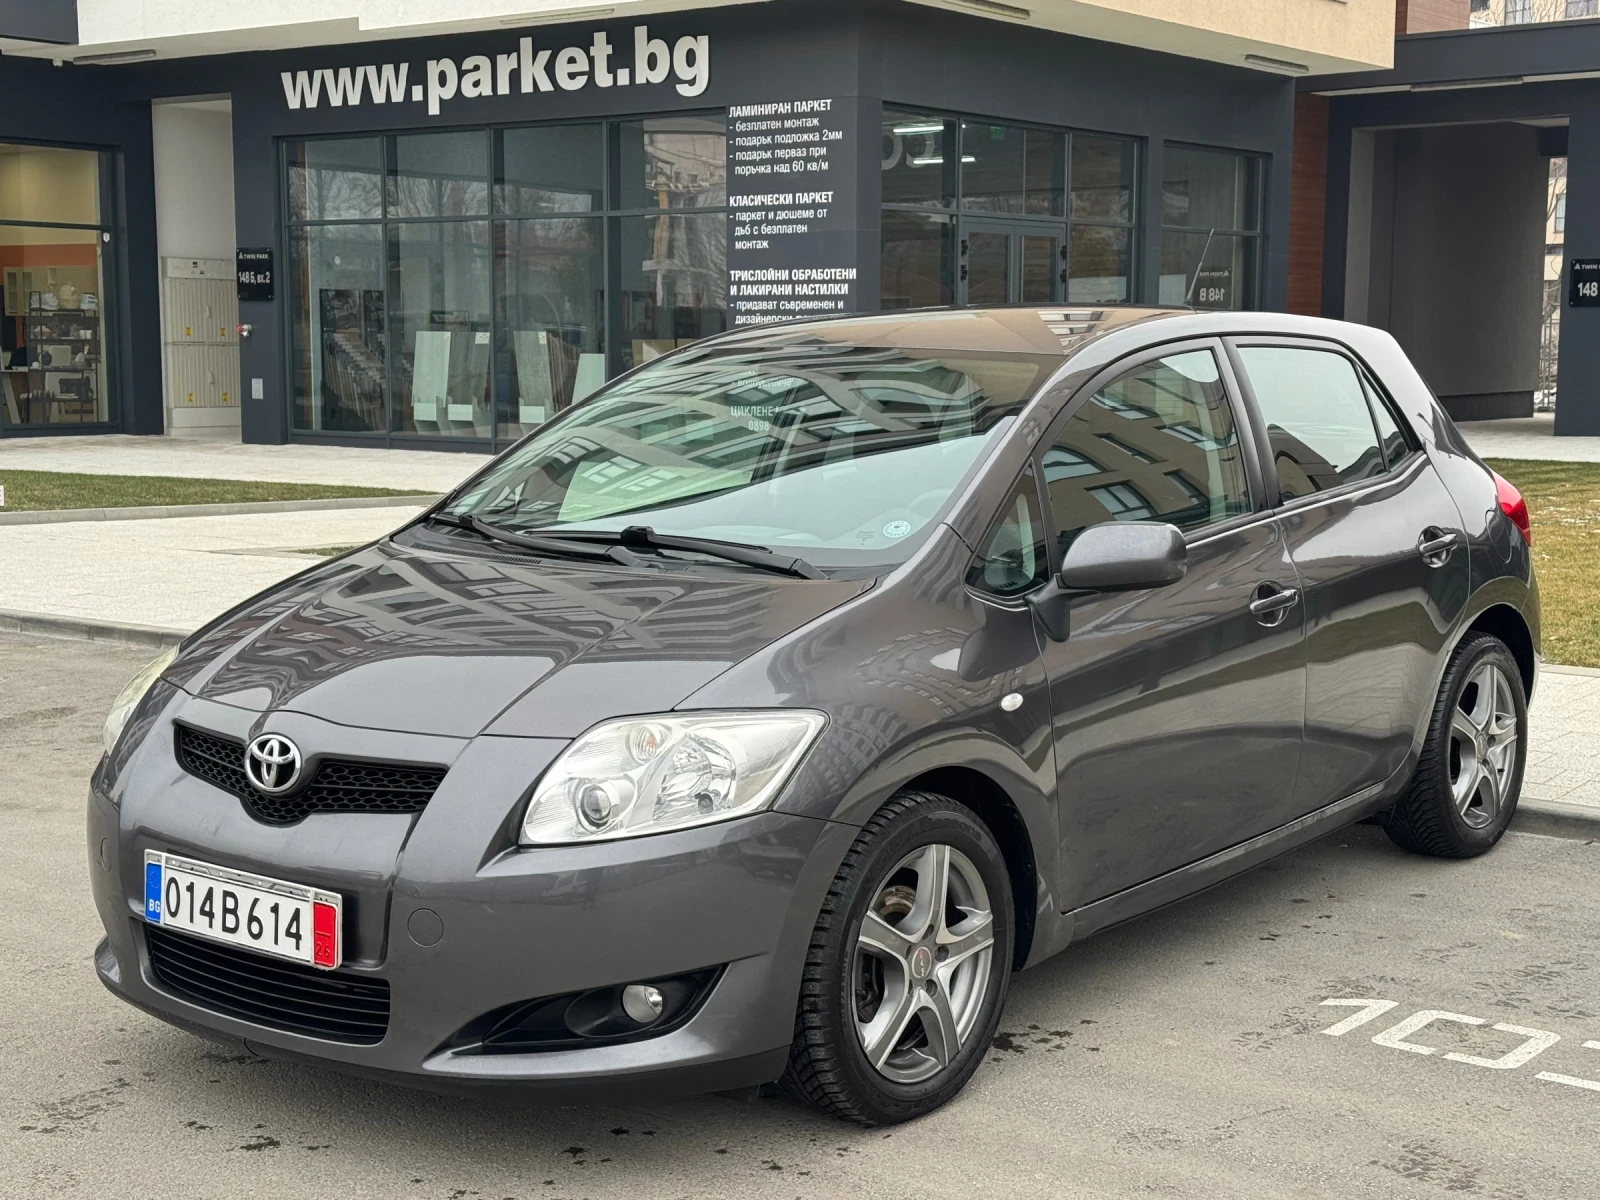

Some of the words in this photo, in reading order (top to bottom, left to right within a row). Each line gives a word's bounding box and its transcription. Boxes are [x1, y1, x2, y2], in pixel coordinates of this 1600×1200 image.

[281, 25, 709, 116] www.parket.bg
[729, 102, 791, 118] ЛАМИНИРАН
[793, 99, 832, 113] ПАРКЕТ
[735, 120, 782, 132] безплатен
[784, 117, 820, 129] монтаж
[735, 136, 772, 147] подарък
[774, 132, 820, 144] подложка
[822, 129, 843, 141] 2мм
[735, 150, 772, 162] подарък
[774, 147, 807, 160] перваз
[809, 146, 827, 158] при
[734, 164, 772, 177] поръчка
[773, 163, 791, 173] над
[792, 160, 804, 172] 60
[806, 159, 829, 172] кв/м
[729, 193, 793, 207] КЛАСИЧЕСКИ
[795, 191, 833, 205] ПАРКЕТ
[735, 211, 766, 223] паркет
[768, 211, 774, 220] и
[775, 209, 815, 221] дюшеме
[817, 208, 828, 218] от
[734, 223, 751, 236] дъб
[753, 225, 759, 235] с
[761, 223, 808, 235] безплатен
[735, 240, 769, 250] монтаж
[730, 268, 789, 282] ТРИСЛОЙНИ
[791, 268, 857, 280] ОБРАБОТЕНИ
[730, 284, 737, 296] И
[739, 284, 792, 296] ЛАКИРАНИ
[795, 283, 849, 295] НАСТИЛКИ
[1578, 281, 1598, 297] 148
[736, 301, 777, 312] придават
[779, 300, 835, 312] съвременен
[837, 301, 844, 309] и
[148, 899, 161, 913] BG
[165, 876, 303, 951] 014B614
